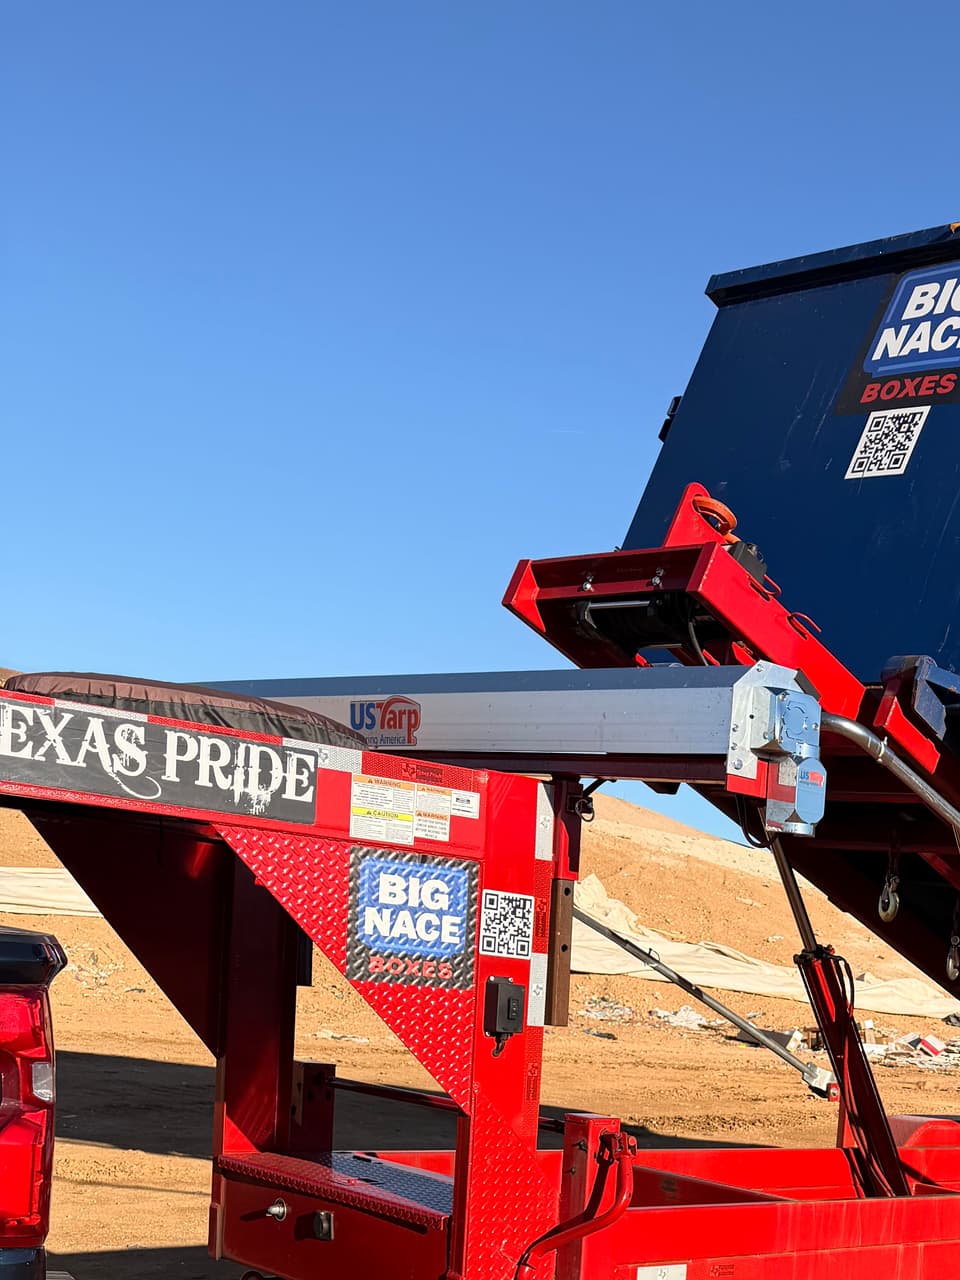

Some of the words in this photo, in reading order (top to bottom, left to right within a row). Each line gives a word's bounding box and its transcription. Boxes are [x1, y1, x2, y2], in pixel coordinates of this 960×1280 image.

[860, 373, 958, 404] BOXES
[380, 734, 406, 744] America
[0, 702, 161, 799] EXAS
[161, 730, 316, 814] PRIDE
[372, 810, 399, 819] CAUTION
[378, 872, 450, 911] BIG
[364, 906, 461, 944] NACE
[368, 956, 453, 979] BOXES
